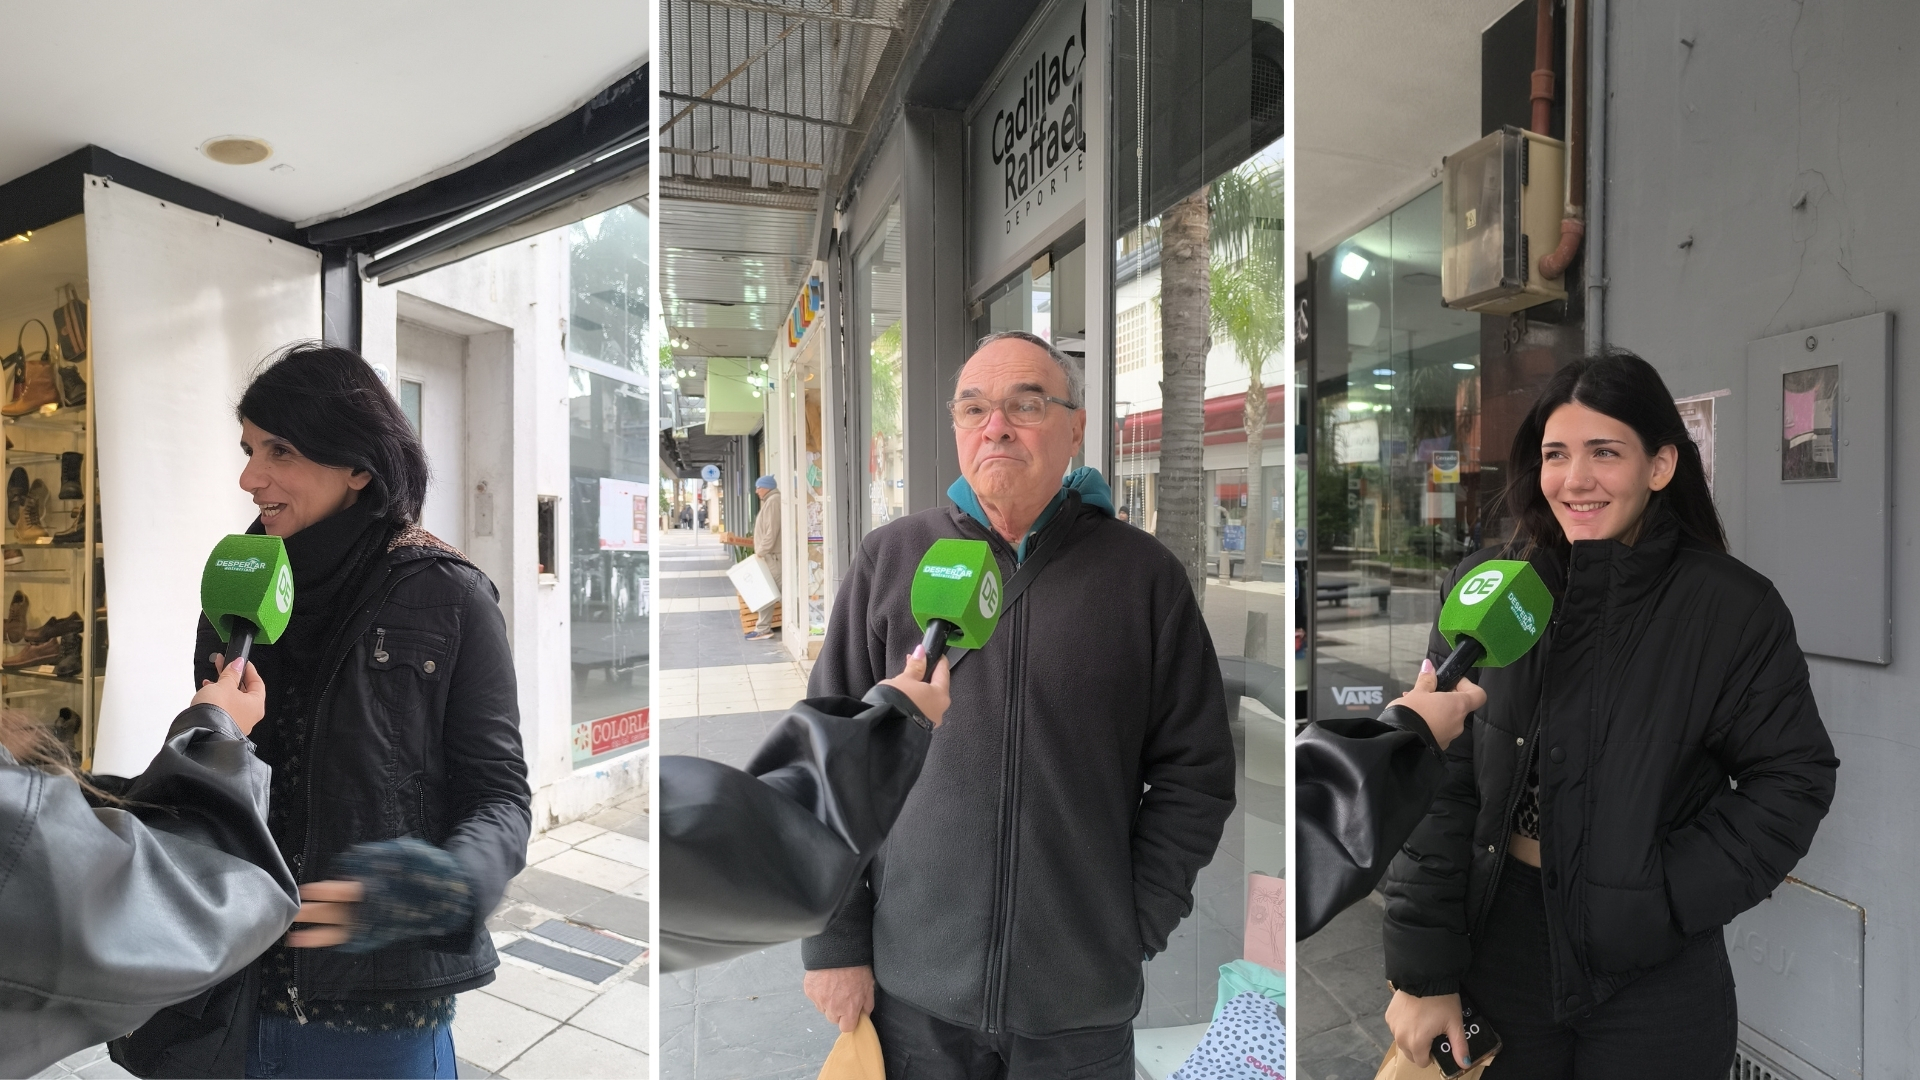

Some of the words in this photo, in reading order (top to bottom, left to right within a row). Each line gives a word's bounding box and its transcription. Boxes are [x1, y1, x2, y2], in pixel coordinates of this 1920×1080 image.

[992, 35, 1076, 165] Cadillac
[279, 571, 292, 608] DE
[982, 576, 998, 613] DE
[1463, 578, 1500, 595] DE
[1331, 686, 1384, 705] VANS
